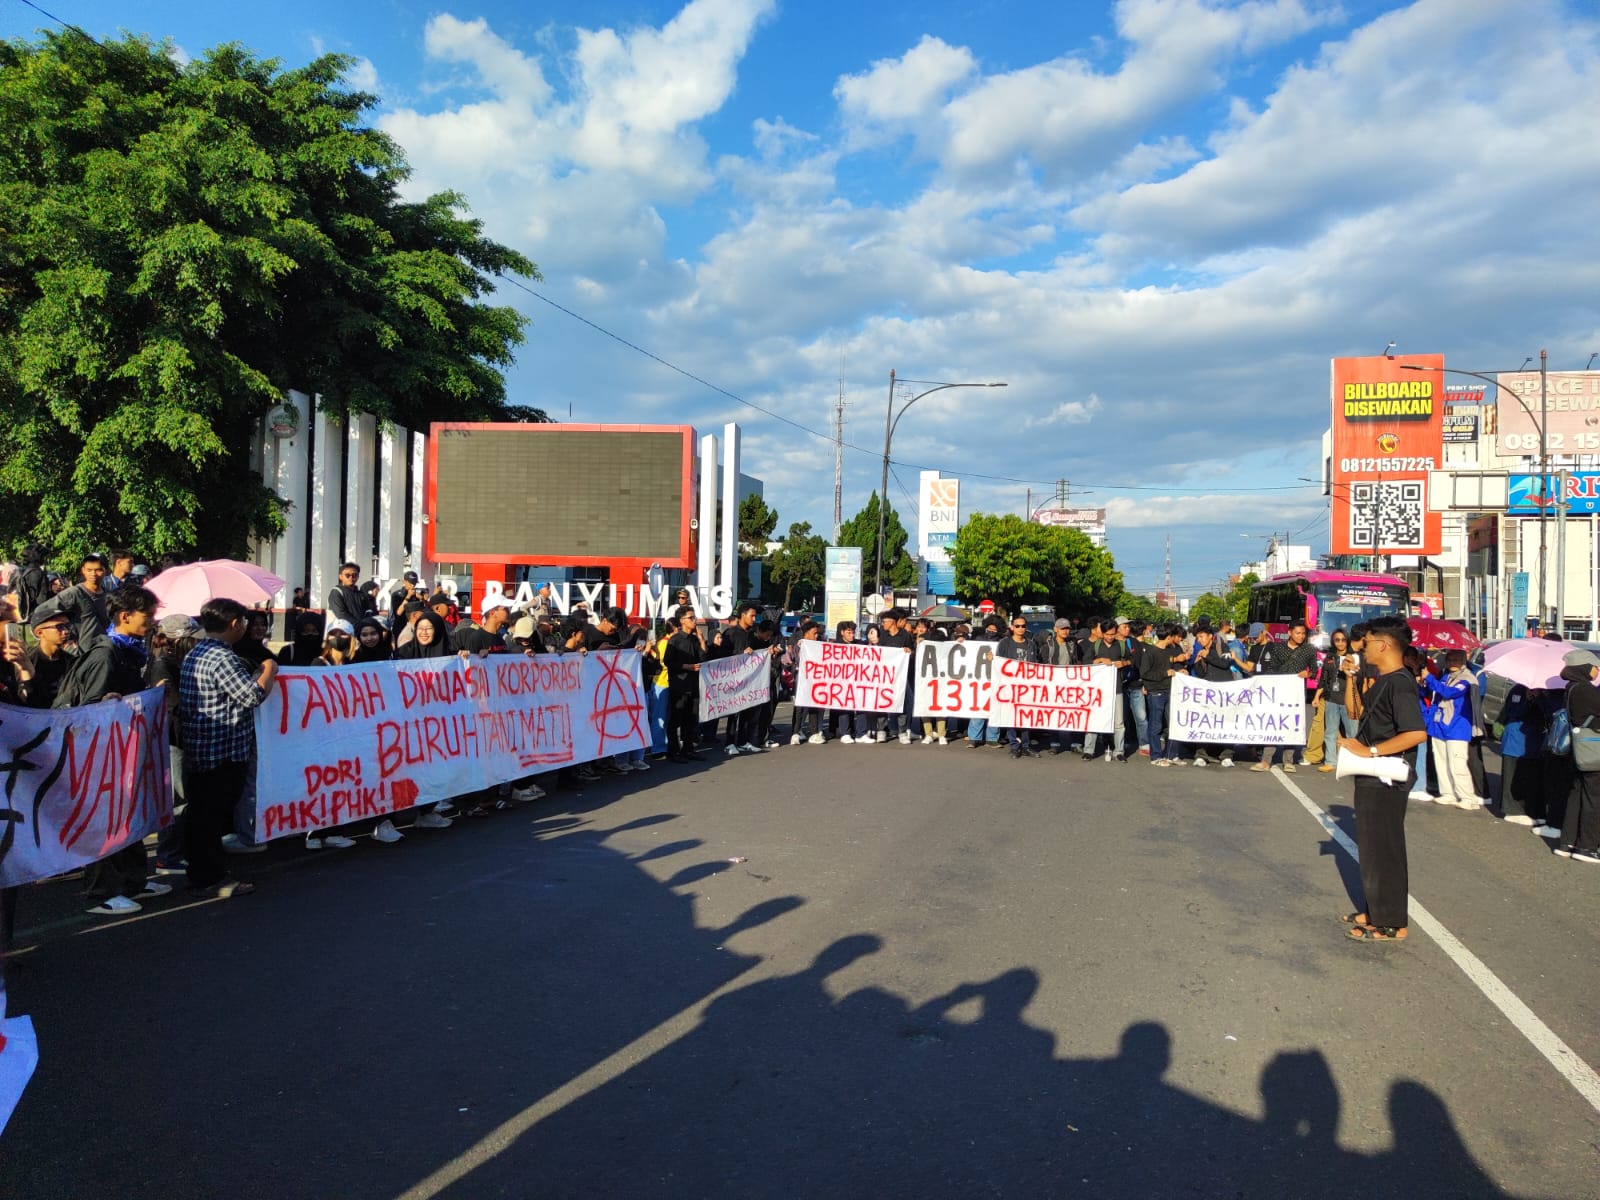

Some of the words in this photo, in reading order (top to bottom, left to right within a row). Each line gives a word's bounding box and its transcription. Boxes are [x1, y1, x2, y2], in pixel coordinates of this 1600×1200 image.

[1344, 381, 1433, 400] BILLBOARD
[1510, 379, 1584, 395] SPACE
[1344, 399, 1433, 417] DISEWAKAN
[1341, 457, 1435, 473] 08121557225
[1565, 476, 1600, 498] RI
[930, 510, 955, 522] BNI
[930, 534, 951, 542] ATM
[1337, 589, 1388, 597] PARIWISATA
[822, 643, 882, 662] BERIKAN
[805, 660, 895, 684] PENDIDIKAN
[1001, 659, 1054, 682] CABUT
[273, 671, 386, 735] TANAH
[397, 665, 490, 710] DIKUASAI
[497, 660, 583, 696] KORPORASI
[811, 682, 894, 710] GRATIS
[996, 684, 1049, 704] CIPTA
[1055, 685, 1103, 708] KERJA
[1019, 708, 1053, 727] MAY
[1057, 710, 1084, 729] DAY
[1177, 709, 1225, 730] UPAH
[376, 714, 479, 780] BURUH
[304, 756, 364, 796] DOR!
